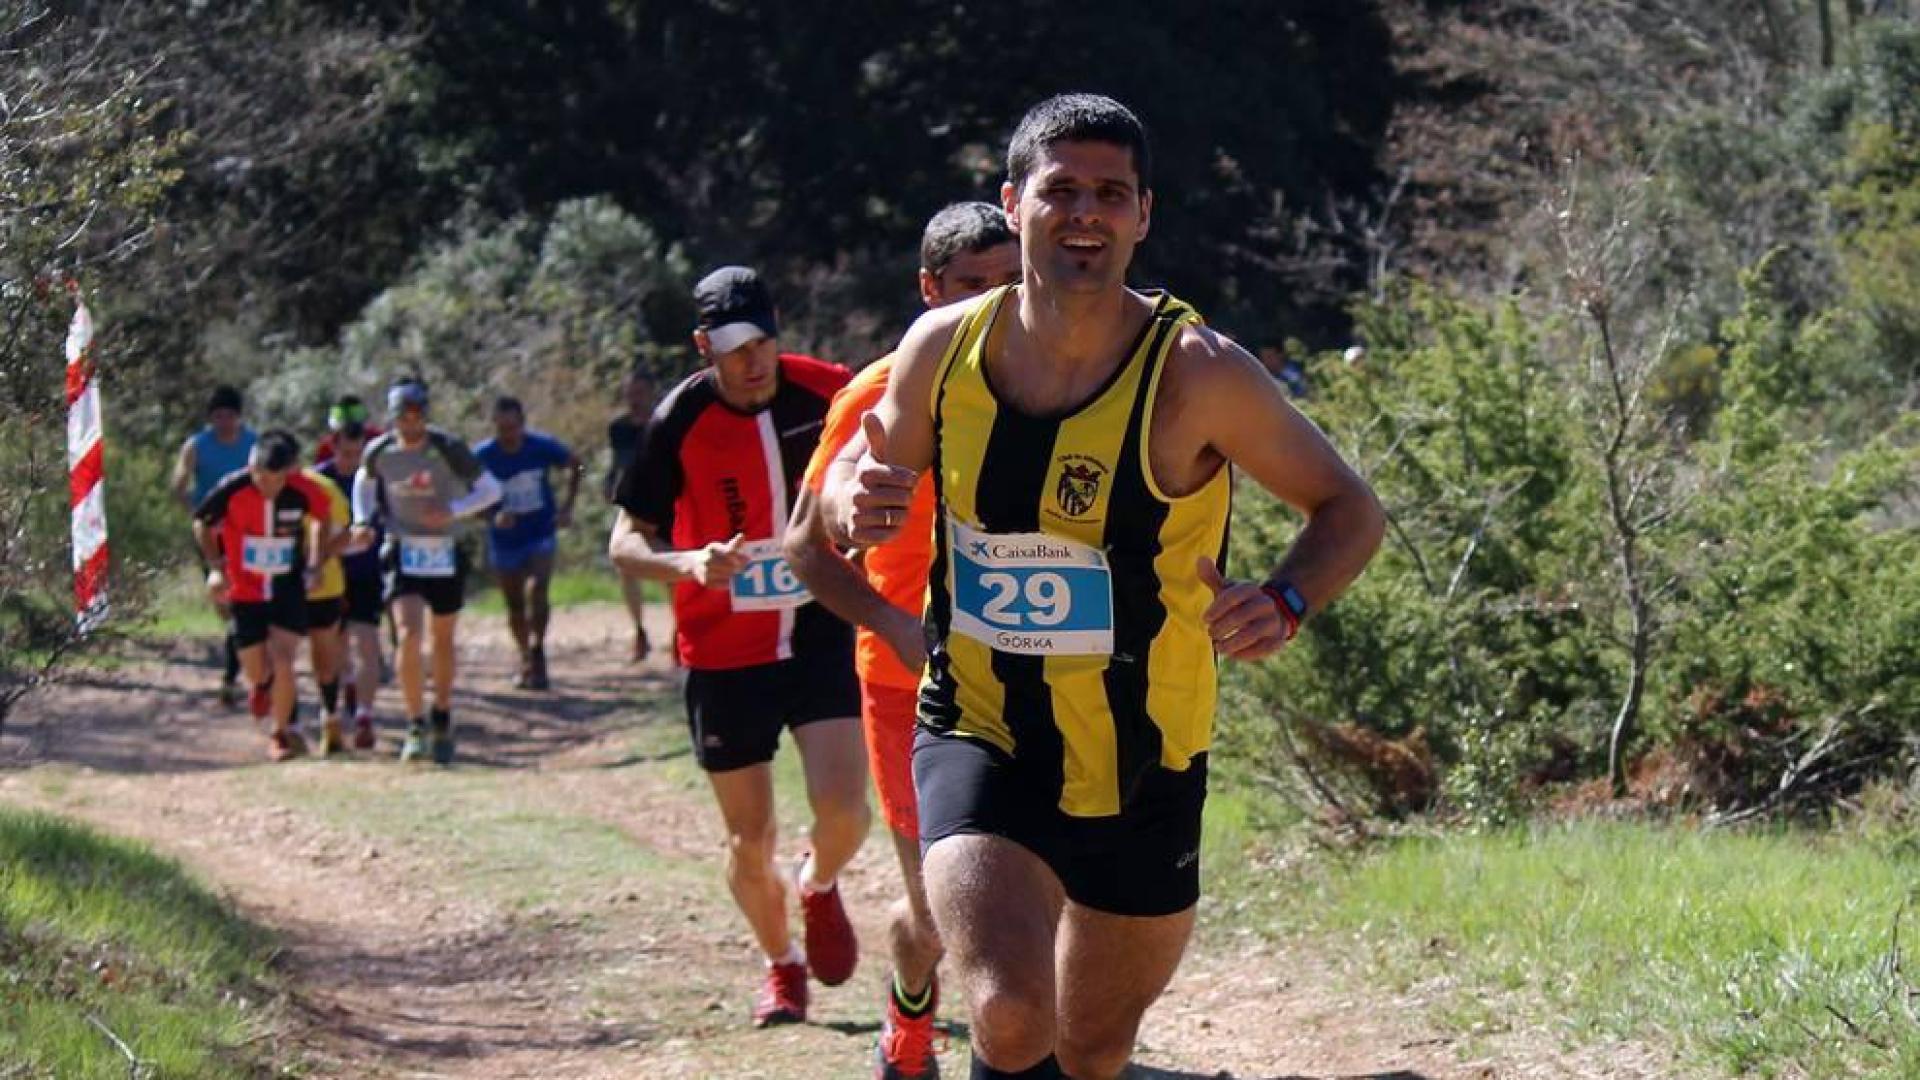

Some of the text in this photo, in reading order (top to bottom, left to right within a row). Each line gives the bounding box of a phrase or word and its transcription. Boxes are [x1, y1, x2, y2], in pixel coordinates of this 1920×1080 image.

[992, 544, 1072, 559] CaixaBank
[743, 561, 800, 594] 16
[979, 571, 1072, 626] 29
[996, 632, 1054, 649] GORKA
